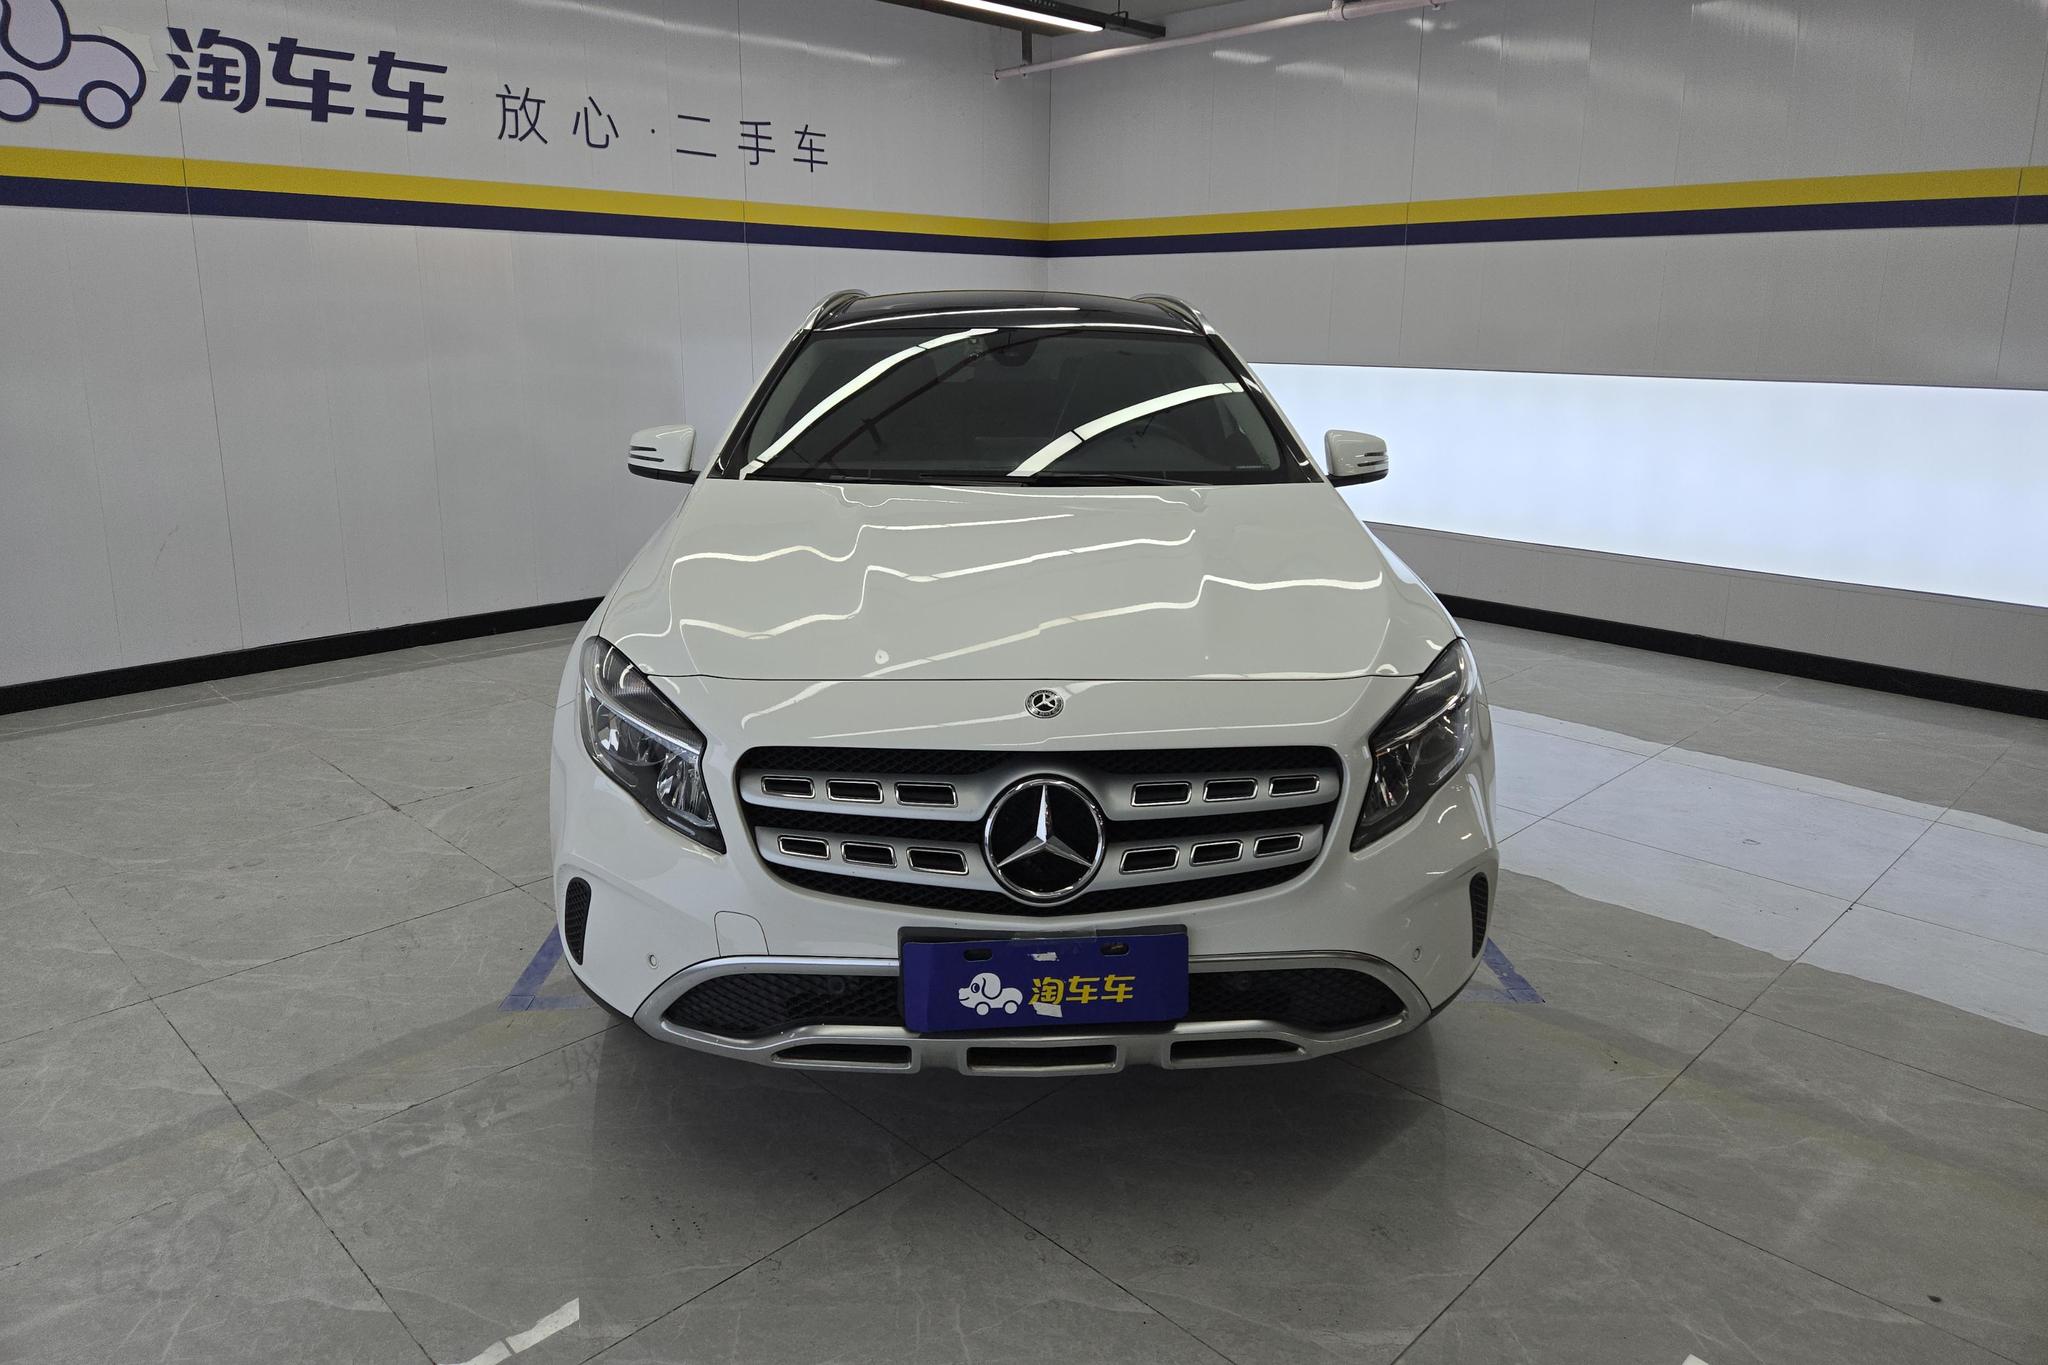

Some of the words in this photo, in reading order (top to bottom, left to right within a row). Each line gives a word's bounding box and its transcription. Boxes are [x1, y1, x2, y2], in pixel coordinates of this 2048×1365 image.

[160, 27, 448, 132] 淘车车
[1029, 974, 1136, 1005] 淘车车
